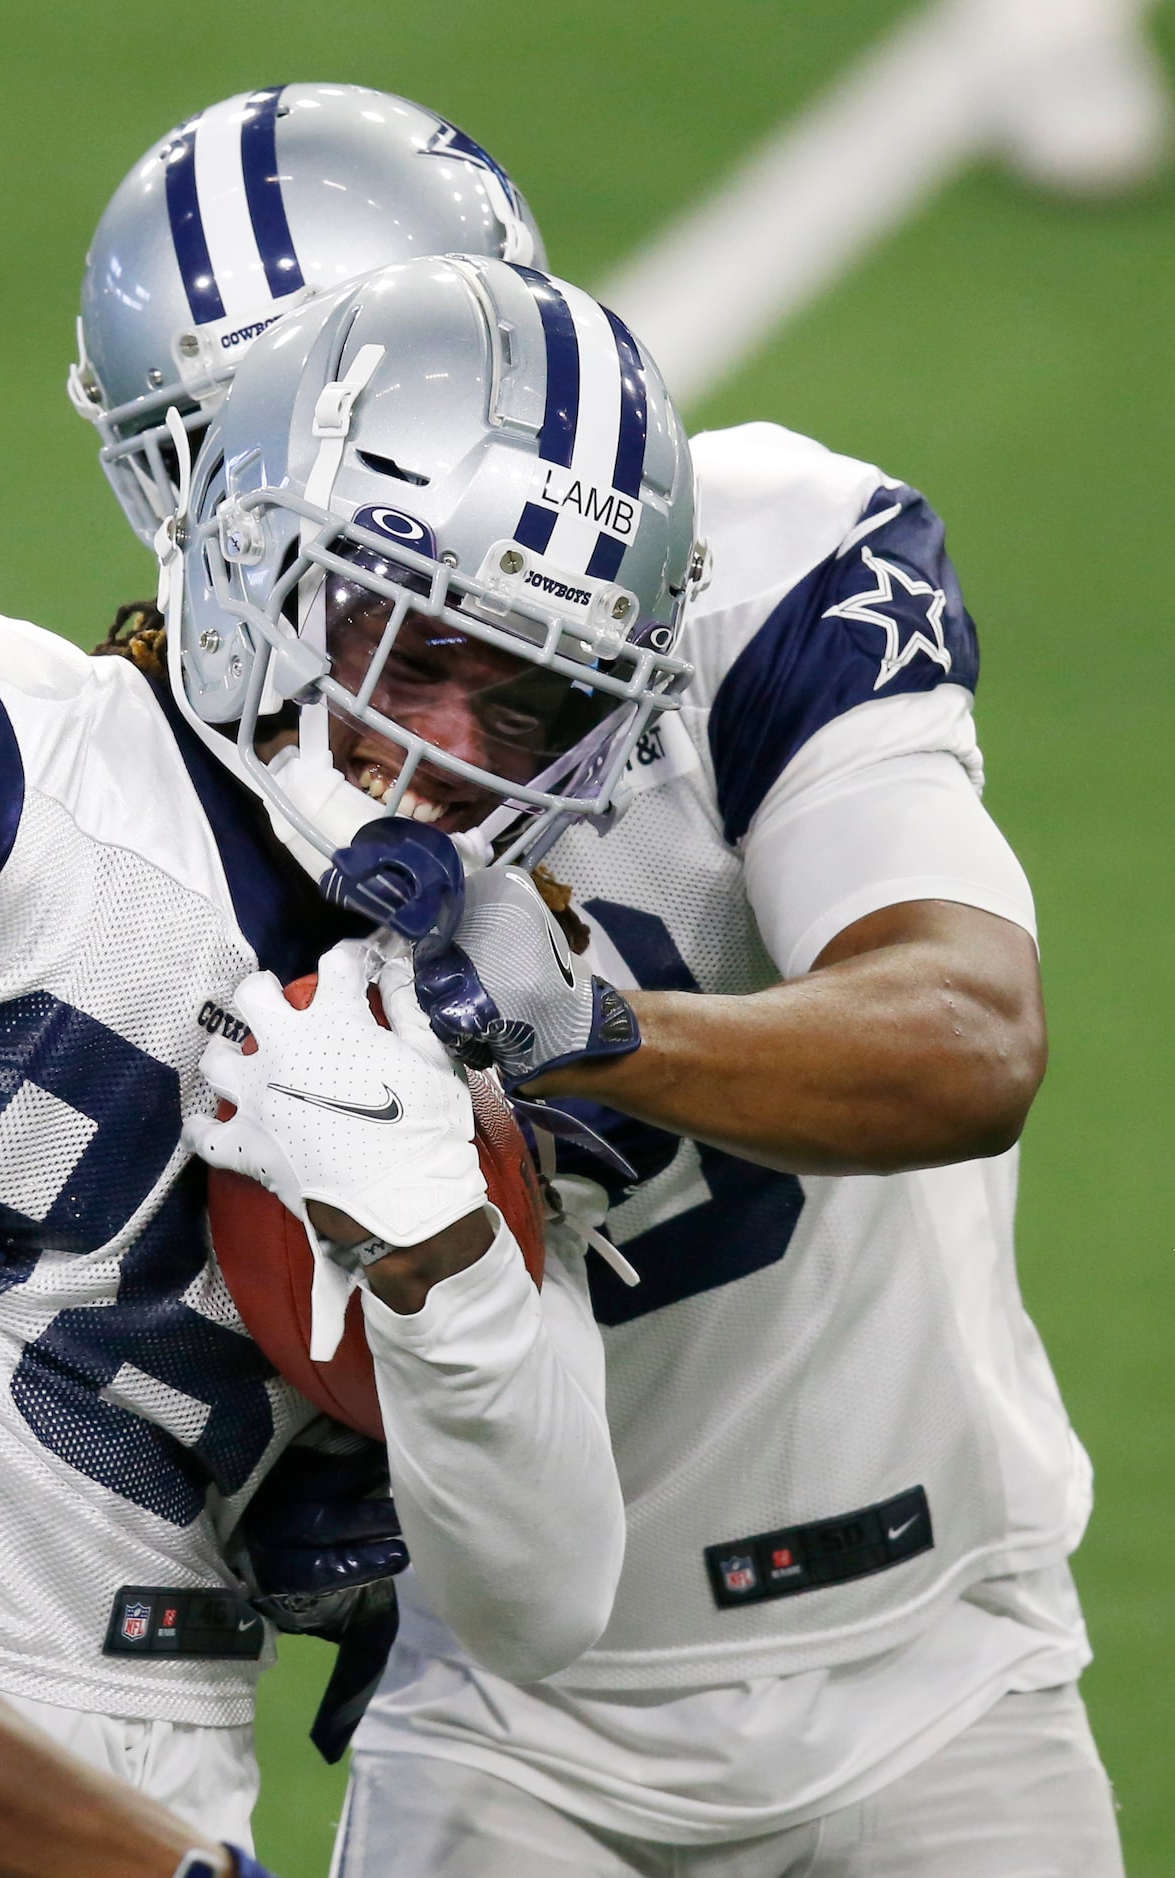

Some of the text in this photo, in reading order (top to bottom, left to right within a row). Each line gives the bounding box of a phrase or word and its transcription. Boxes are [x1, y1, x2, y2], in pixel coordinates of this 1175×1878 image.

[541, 469, 634, 535] LAMB
[727, 1570, 753, 1589] NFL
[124, 1619, 143, 1636] NFL
